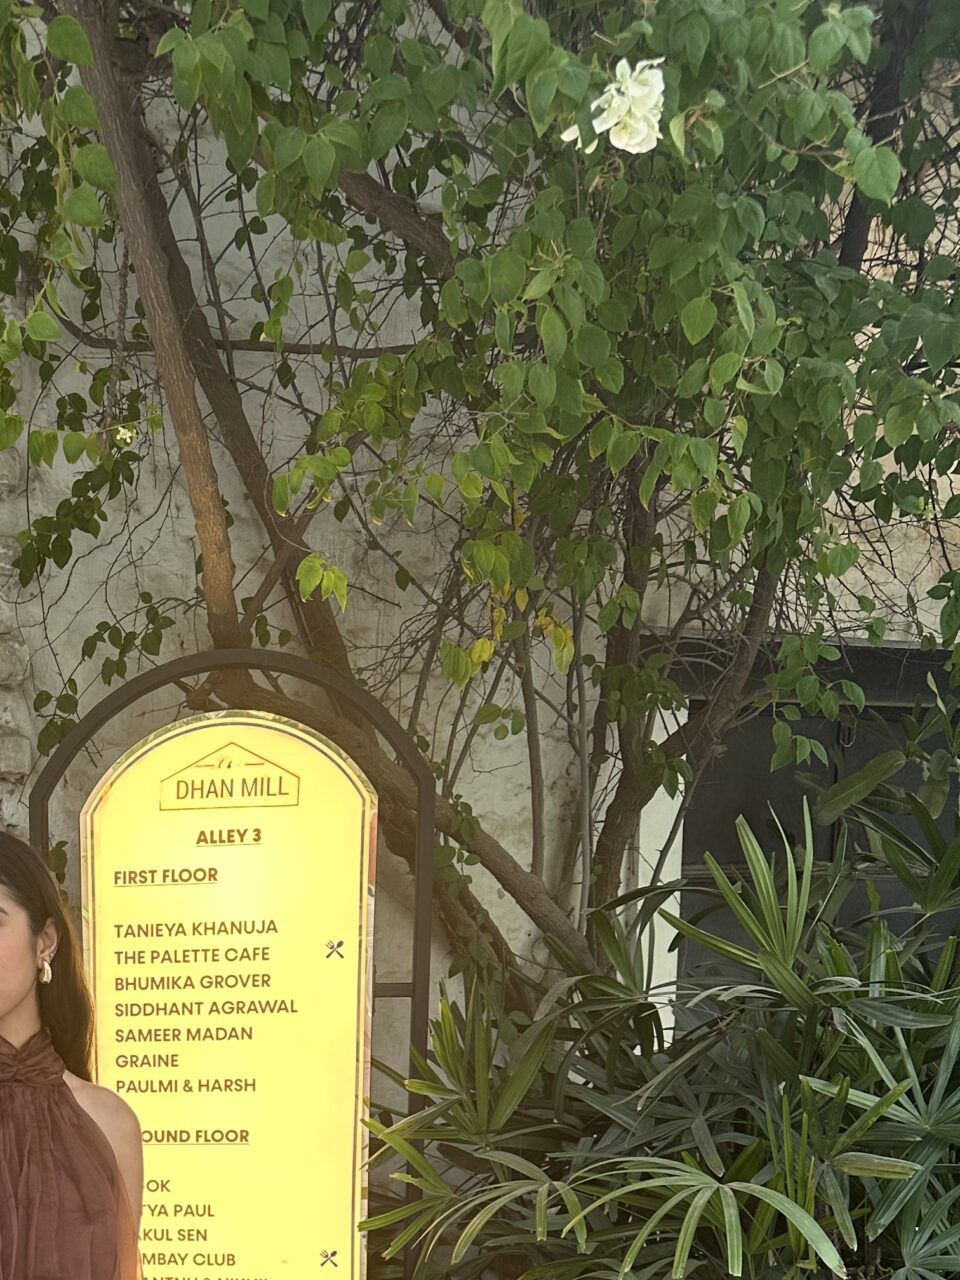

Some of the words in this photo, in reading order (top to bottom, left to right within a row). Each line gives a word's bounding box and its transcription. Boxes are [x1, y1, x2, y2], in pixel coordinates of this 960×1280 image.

[176, 778, 234, 800] DHAN
[241, 775, 290, 797] MILL
[196, 828, 248, 845] ALLEY
[252, 828, 262, 843] 3
[114, 869, 158, 885] FIRST
[162, 867, 218, 883] FLOOR
[114, 923, 187, 938] TANIEYA
[192, 920, 278, 936] KHANUJA
[114, 950, 146, 965] THE
[150, 948, 220, 964] PALETTE
[224, 947, 270, 962] CAFE
[114, 976, 196, 991] BHUMIKA
[200, 973, 271, 989] GROVER
[114, 1002, 204, 1017] SIDDHANT
[208, 999, 298, 1015] AGRAWAL
[115, 1028, 182, 1043] SAMEER
[186, 1026, 253, 1041] MADAN
[115, 1054, 179, 1068] GRAINE
[116, 1079, 178, 1093] PAULMI
[182, 1079, 194, 1093] &
[198, 1078, 256, 1092] HARSH
[141, 1129, 191, 1143] OUND
[195, 1129, 249, 1143] FLOOR
[173, 1204, 215, 1217] PAUL
[142, 1228, 173, 1241] KUL
[177, 1228, 207, 1241] SEN
[142, 1252, 189, 1266] MBAY
[193, 1253, 236, 1266] CLUB
